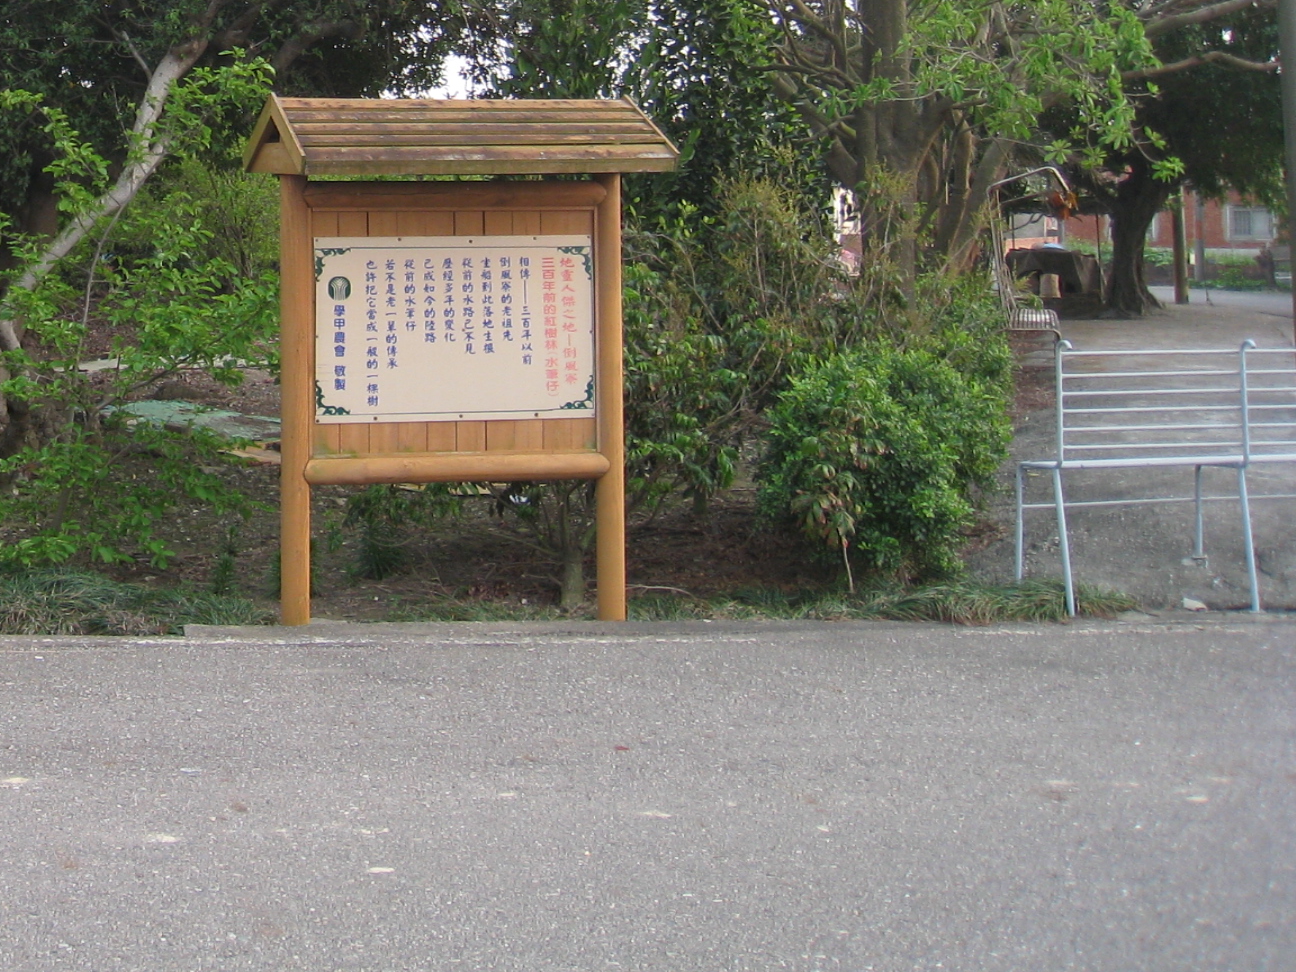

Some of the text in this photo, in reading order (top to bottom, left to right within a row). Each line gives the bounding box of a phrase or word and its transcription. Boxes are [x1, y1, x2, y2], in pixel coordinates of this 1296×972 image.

[404, 259, 417, 332] 從前的水筆仔
[333, 304, 346, 391] 學甲農會 敬製
